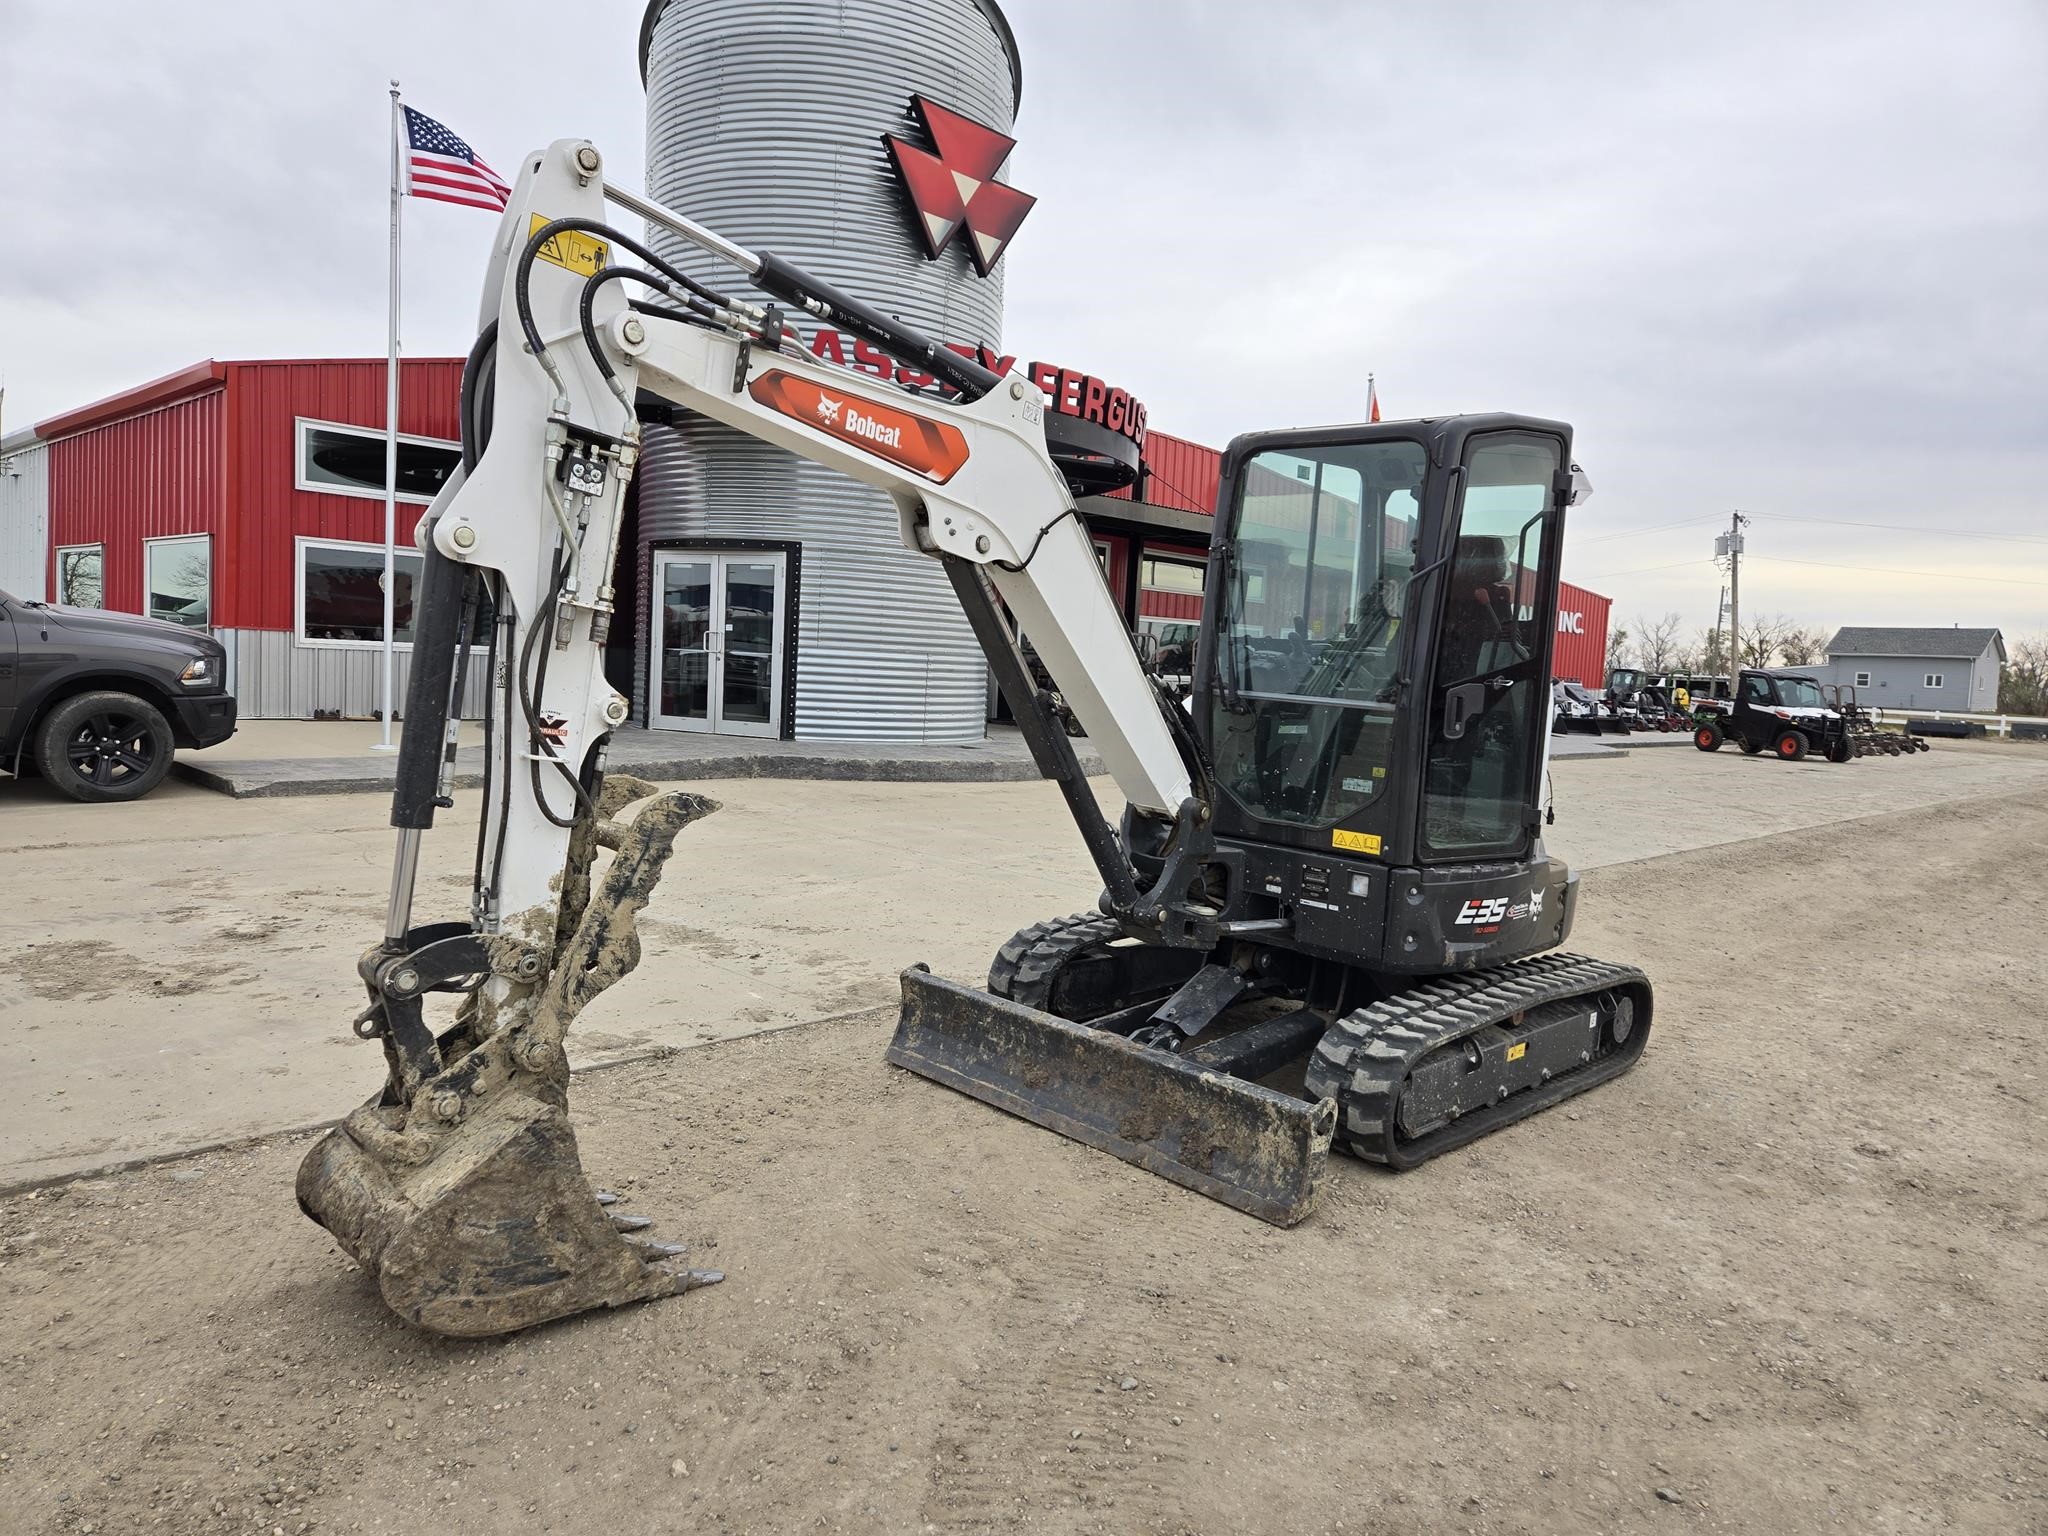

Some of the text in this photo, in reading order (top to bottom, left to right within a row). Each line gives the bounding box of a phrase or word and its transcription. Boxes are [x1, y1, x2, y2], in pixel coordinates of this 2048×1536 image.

[1029, 361, 1148, 451] FERGUS
[845, 408, 901, 449] Bobcat
[1557, 610, 1584, 635] INC.
[1454, 897, 1509, 925] E35
